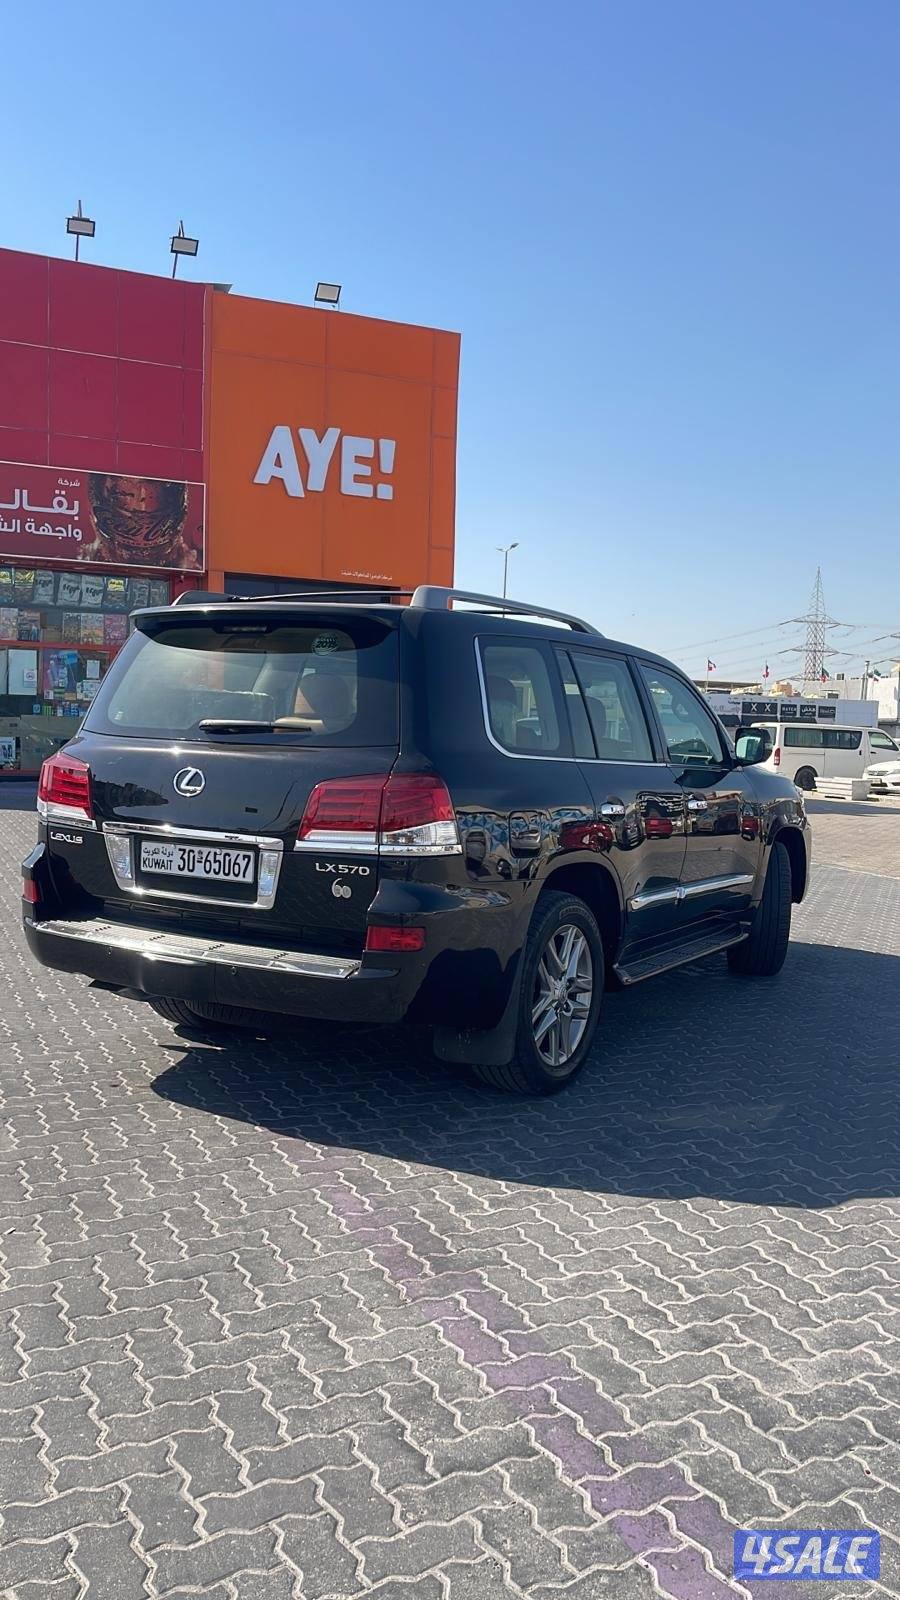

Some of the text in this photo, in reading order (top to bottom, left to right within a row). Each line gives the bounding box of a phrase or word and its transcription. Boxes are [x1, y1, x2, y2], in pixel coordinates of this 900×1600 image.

[253, 425, 396, 500] AYE!
[57, 477, 81, 488] شركة
[0, 488, 79, 521] بقال
[25, 518, 82, 541] واجهة
[50, 831, 84, 844] LEXUS
[142, 857, 173, 870] KUWAIT
